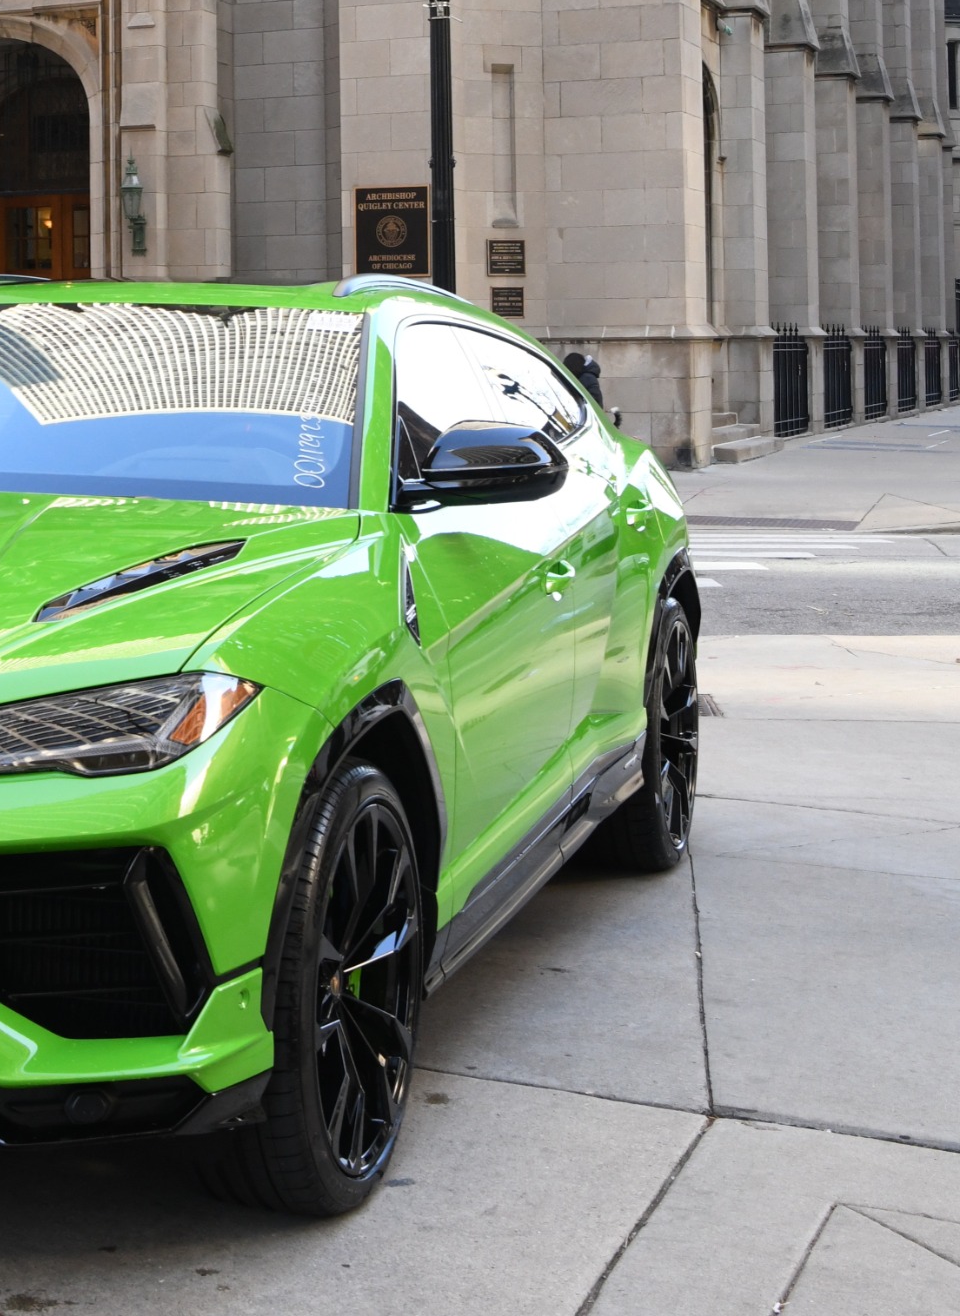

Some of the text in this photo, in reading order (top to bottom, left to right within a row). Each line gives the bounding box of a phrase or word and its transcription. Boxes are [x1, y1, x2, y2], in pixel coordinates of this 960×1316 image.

[366, 192, 417, 201] ARCHBISHOP
[357, 201, 425, 211] QUIGLEY CENTER
